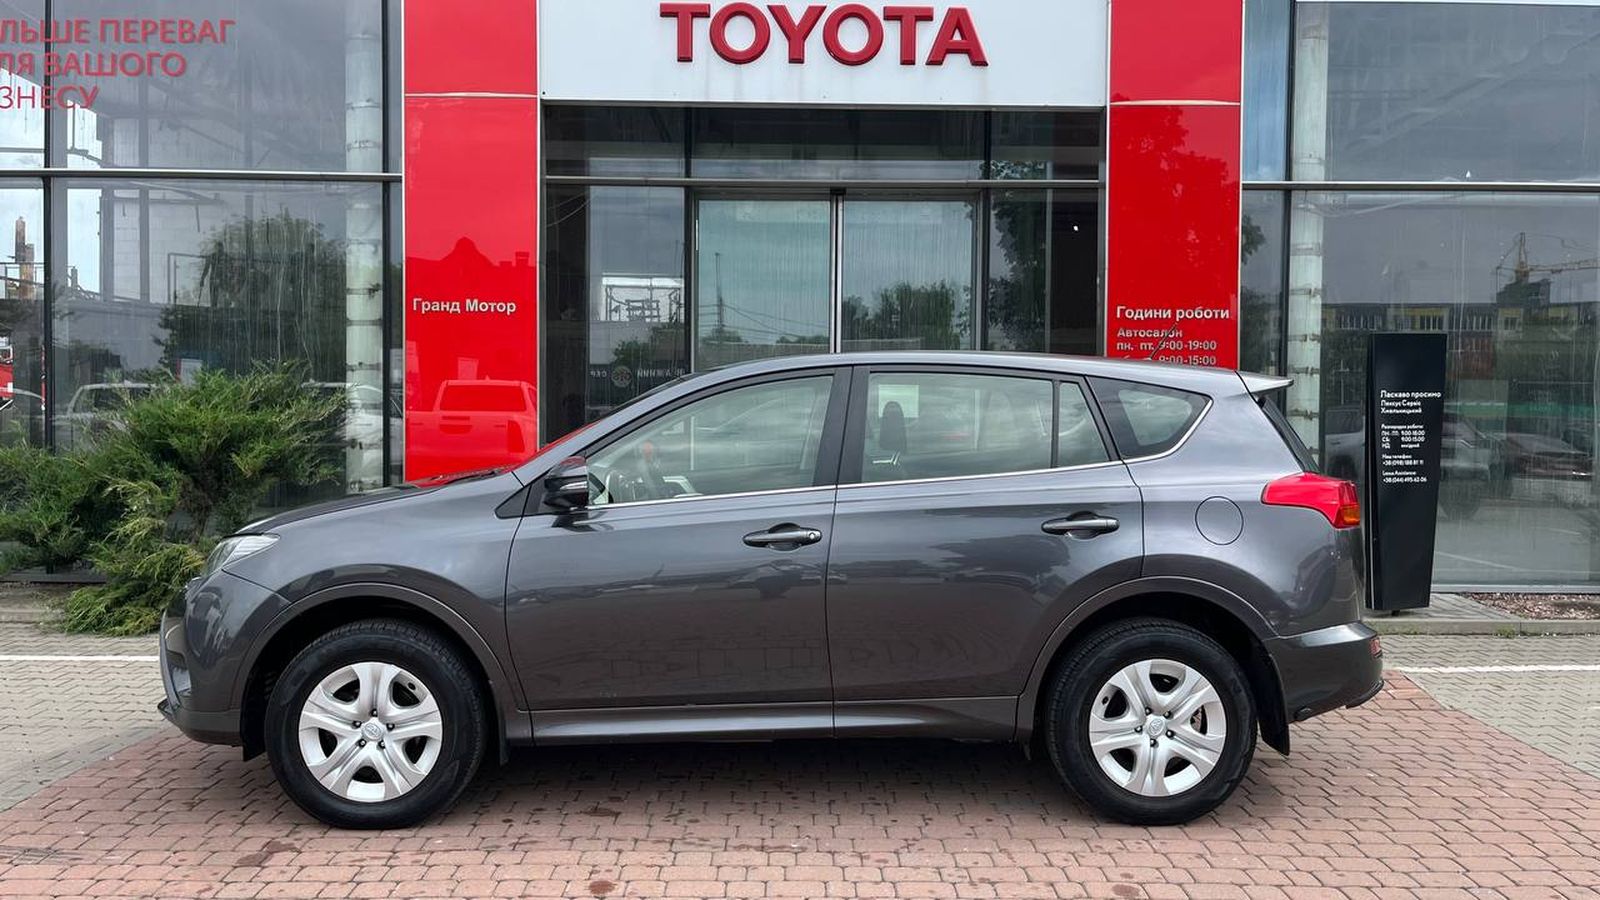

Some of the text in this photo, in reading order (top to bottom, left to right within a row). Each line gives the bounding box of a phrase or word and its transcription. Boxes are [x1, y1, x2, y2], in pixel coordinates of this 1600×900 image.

[100, 20, 236, 44] ПЕРЕВАГ
[660, 2, 989, 66] TOYOTA
[45, 53, 187, 77] ВАШОГО
[413, 298, 517, 315] Гранд Мотор
[1116, 305, 1230, 321] Години роботи
[1117, 328, 1183, 338] Автосалон
[1380, 390, 1442, 399] Ласкаво просимо
